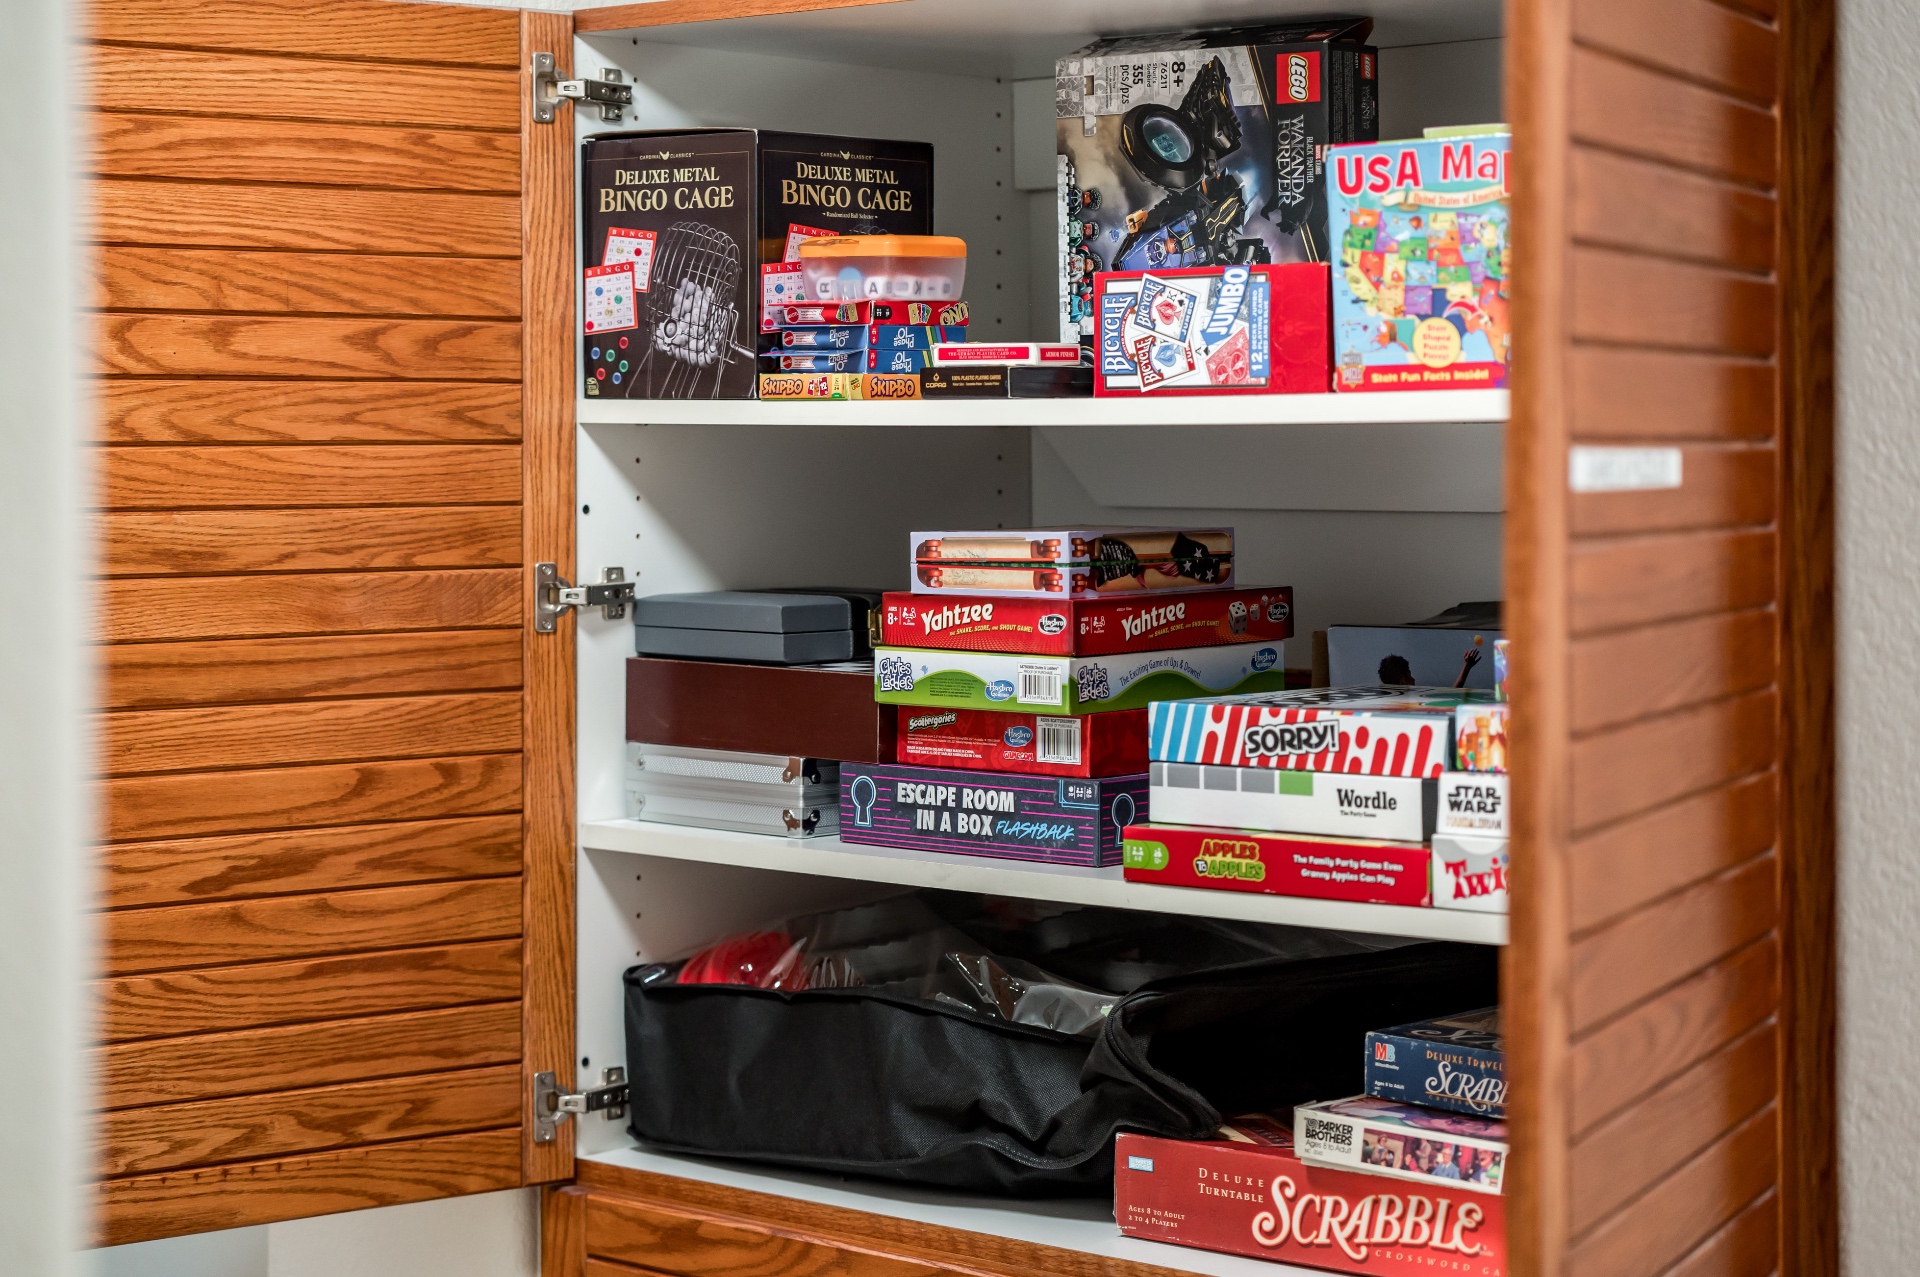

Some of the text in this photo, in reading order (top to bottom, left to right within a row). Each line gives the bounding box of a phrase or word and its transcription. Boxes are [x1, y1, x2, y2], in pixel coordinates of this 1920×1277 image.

[1132, 64, 1144, 85] 355
[1160, 62, 1168, 89] 76211
[1171, 61, 1186, 88] 8+
[1363, 55, 1371, 78] LEGO
[1120, 65, 1133, 105] pcs/pzs
[1288, 55, 1308, 102] LEGO
[1276, 118, 1292, 207] FOREVER
[1291, 114, 1305, 207] WAKANDA
[1306, 136, 1314, 183] BLACK PANTHER
[614, 166, 720, 186] DELUXE METAL
[797, 161, 899, 185] DELUXE METAL
[1336, 150, 1422, 196] USA
[599, 186, 734, 213] BINGO CAGE
[781, 179, 913, 212] BINGO CAGE
[1136, 281, 1163, 329] BICYCLE
[1206, 268, 1249, 336] JUMBO
[1182, 301, 1194, 337] JUMBO
[830, 329, 850, 341] Phase
[835, 337, 846, 348] 10
[893, 336, 915, 349] Phase
[897, 327, 909, 338] 10
[1104, 295, 1136, 372] BICYCLE
[828, 354, 848, 365] Phase
[834, 361, 844, 372] 10
[891, 361, 912, 373] Phase
[894, 350, 905, 362] 10
[1137, 338, 1161, 385] BICYCLE
[1251, 351, 1263, 371] 12
[1400, 372, 1421, 382] Fun
[1423, 371, 1451, 381] Facts
[888, 612, 898, 625] 8+
[921, 603, 993, 636] Yahtzee
[1121, 602, 1185, 642] Yahtzee
[880, 657, 912, 681] Chutes
[1077, 663, 1108, 684] Chutes
[1119, 676, 1130, 687] The
[1129, 663, 1150, 681] Exciting
[1149, 660, 1164, 671] Game
[1164, 656, 1171, 668] of
[1171, 656, 1180, 668] Ups
[880, 674, 913, 692] Ladders
[1078, 679, 1109, 702] Ladders
[909, 713, 956, 731] Scattergories
[1246, 723, 1337, 754] SORRY!
[897, 782, 1015, 813] ESCAPE ROOM
[1336, 788, 1398, 811] Wordle
[1448, 785, 1501, 800] STAR
[1448, 800, 1501, 814] WARS
[917, 808, 994, 837] IN A BOX
[995, 820, 1075, 842] FLASHBACK
[1201, 840, 1258, 861] APPLES
[1208, 861, 1265, 880] APPLES
[1293, 854, 1403, 873] The Family Party Game Even
[1301, 868, 1395, 887] Granny Apples Can Play
[1445, 857, 1509, 900] Twi
[1375, 1042, 1397, 1062] MB
[1426, 1050, 1504, 1072] DELUXE TRAVEL
[1305, 1129, 1352, 1147] BROTHERS
[1318, 1119, 1354, 1137] PARKER
[1305, 1138, 1320, 1151] Ages
[1328, 1142, 1334, 1150] to
[1334, 1143, 1352, 1154] Adult
[1198, 1167, 1264, 1188] DELUXE
[1198, 1182, 1264, 1203] TURNTABLE
[1128, 1204, 1145, 1214] AGES
[1164, 1210, 1185, 1220] ADULT
[1151, 1217, 1178, 1228] PLAYERS
[1251, 1175, 1484, 1261] SCRABBLE
[1375, 1249, 1471, 1272] CROSSWORD
[1483, 1266, 1501, 1277] GA
